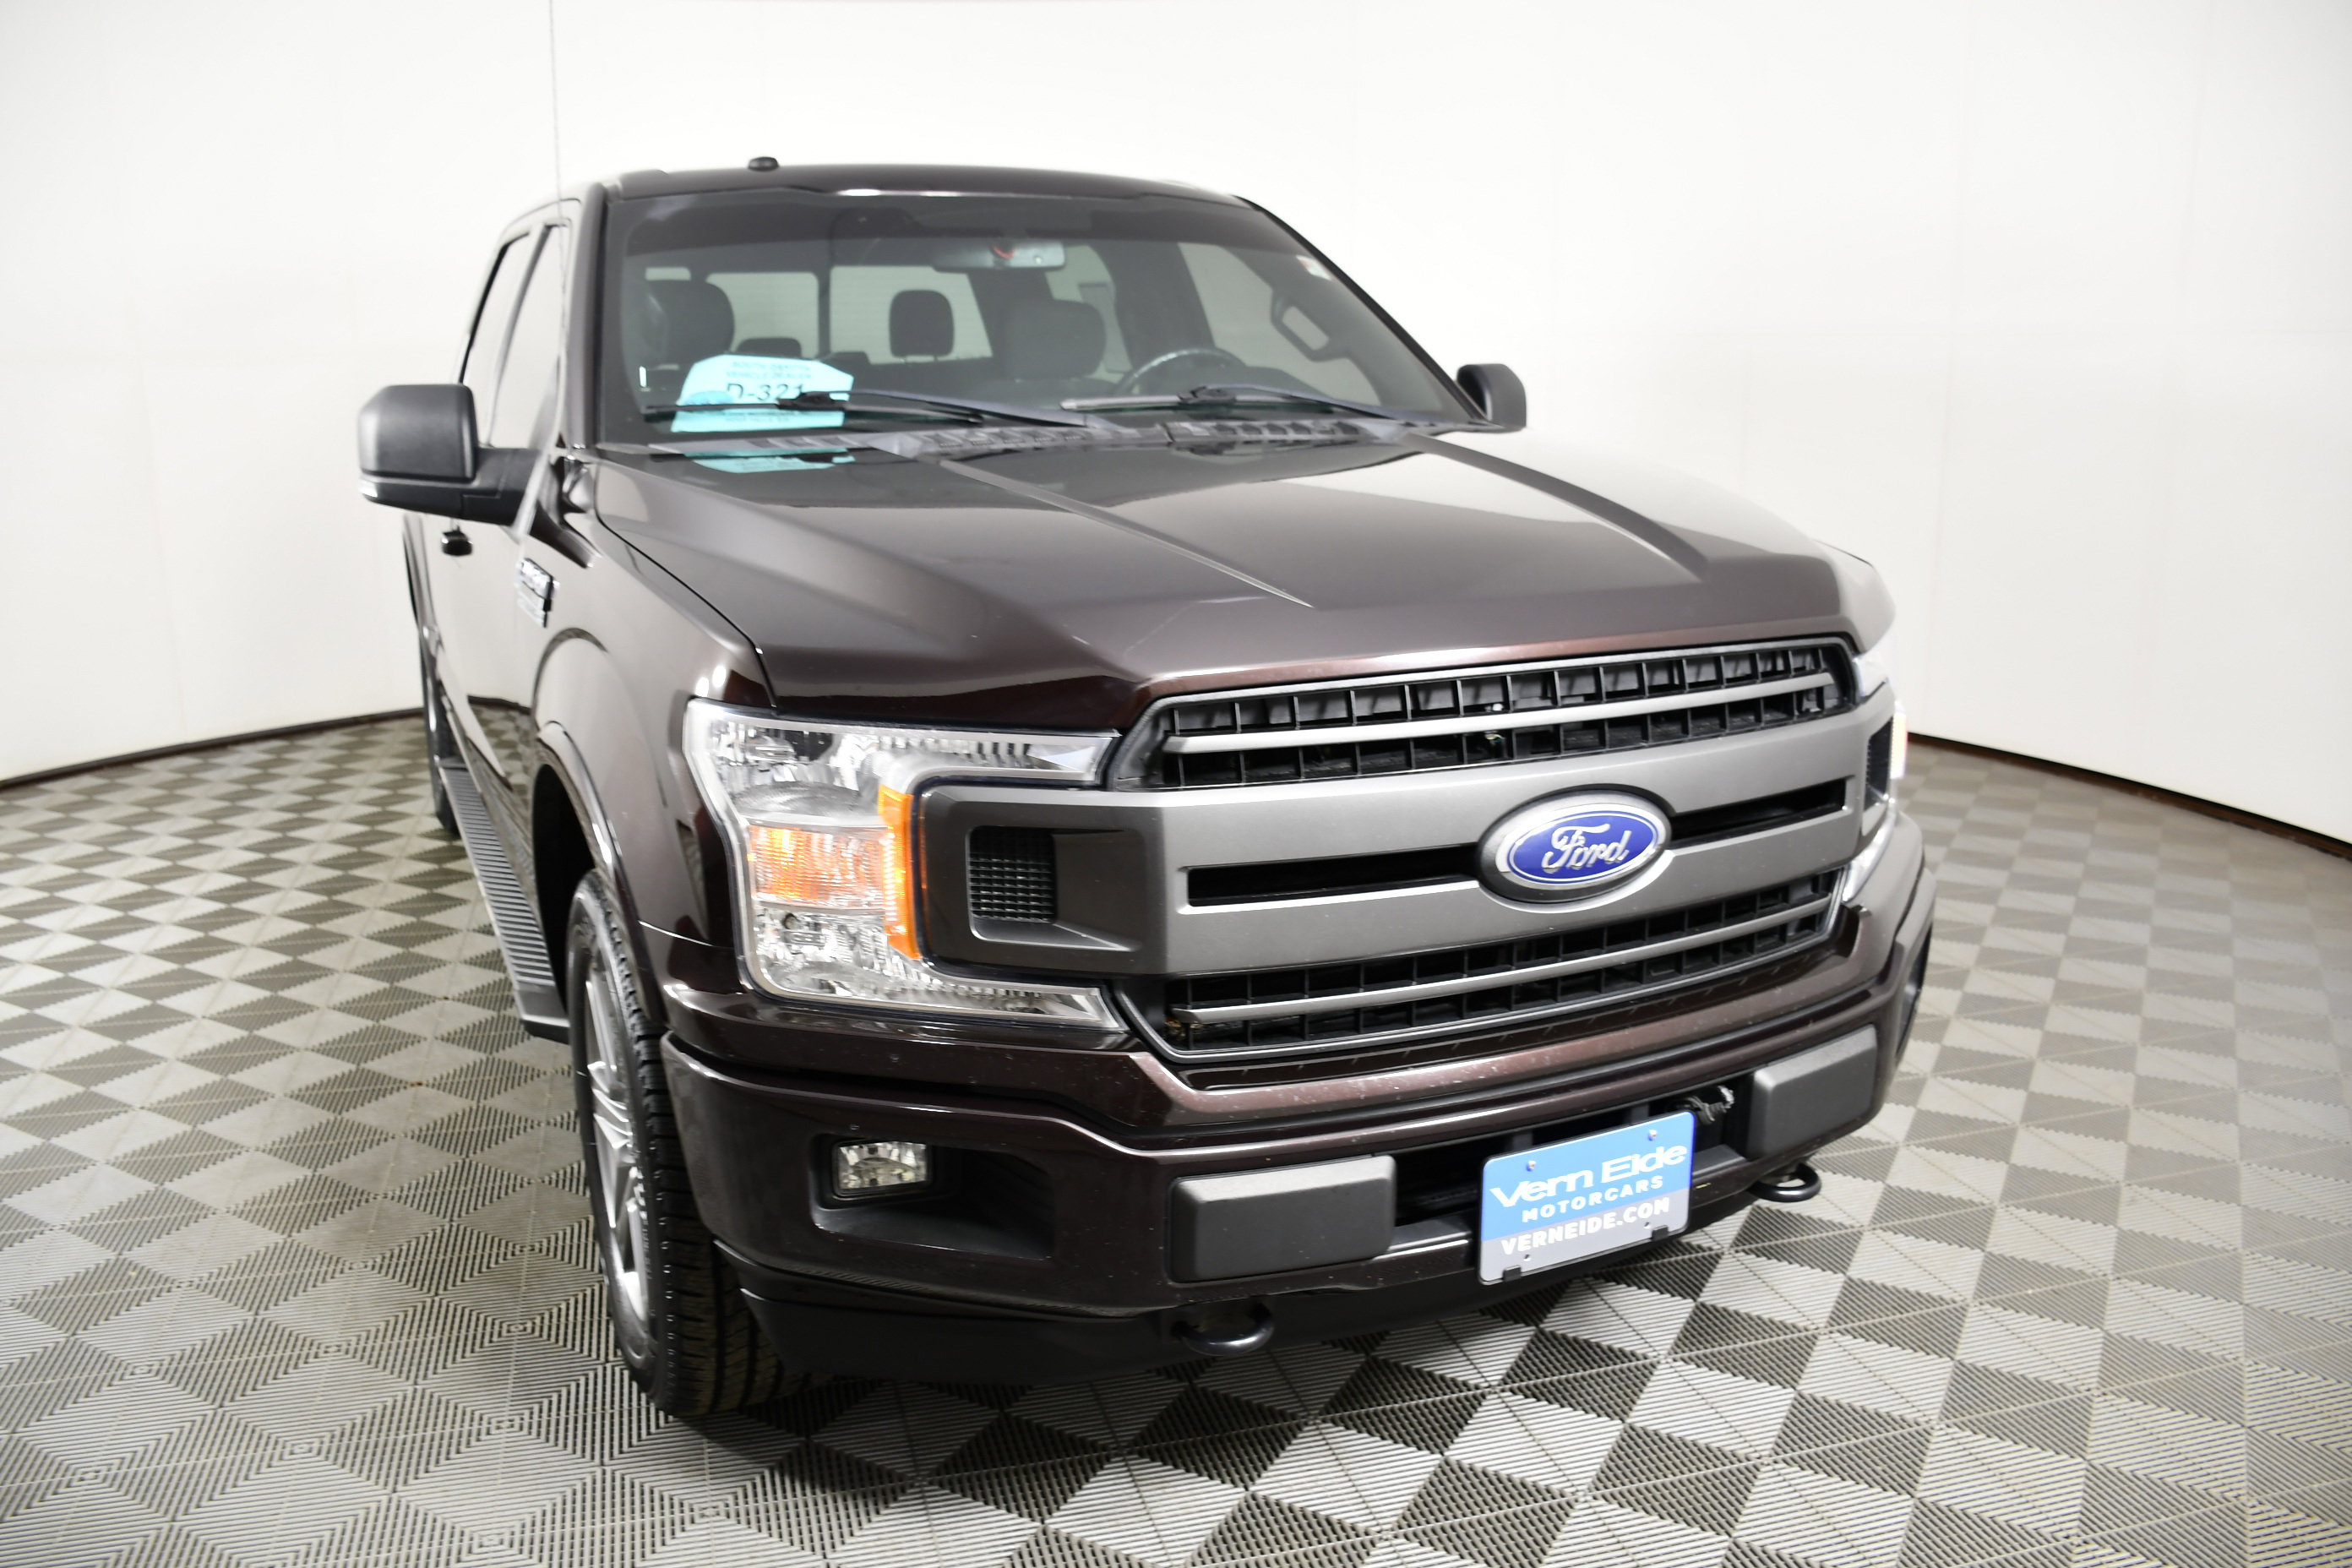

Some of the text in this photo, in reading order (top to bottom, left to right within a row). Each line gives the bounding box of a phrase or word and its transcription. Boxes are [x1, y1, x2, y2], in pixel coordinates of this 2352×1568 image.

[1541, 823, 1632, 870] Ford
[1489, 1145, 1688, 1207] Vern Eide
[1522, 1175, 1663, 1222] MOTORCARS
[1500, 1196, 1670, 1255] VERNEIDE.COM
